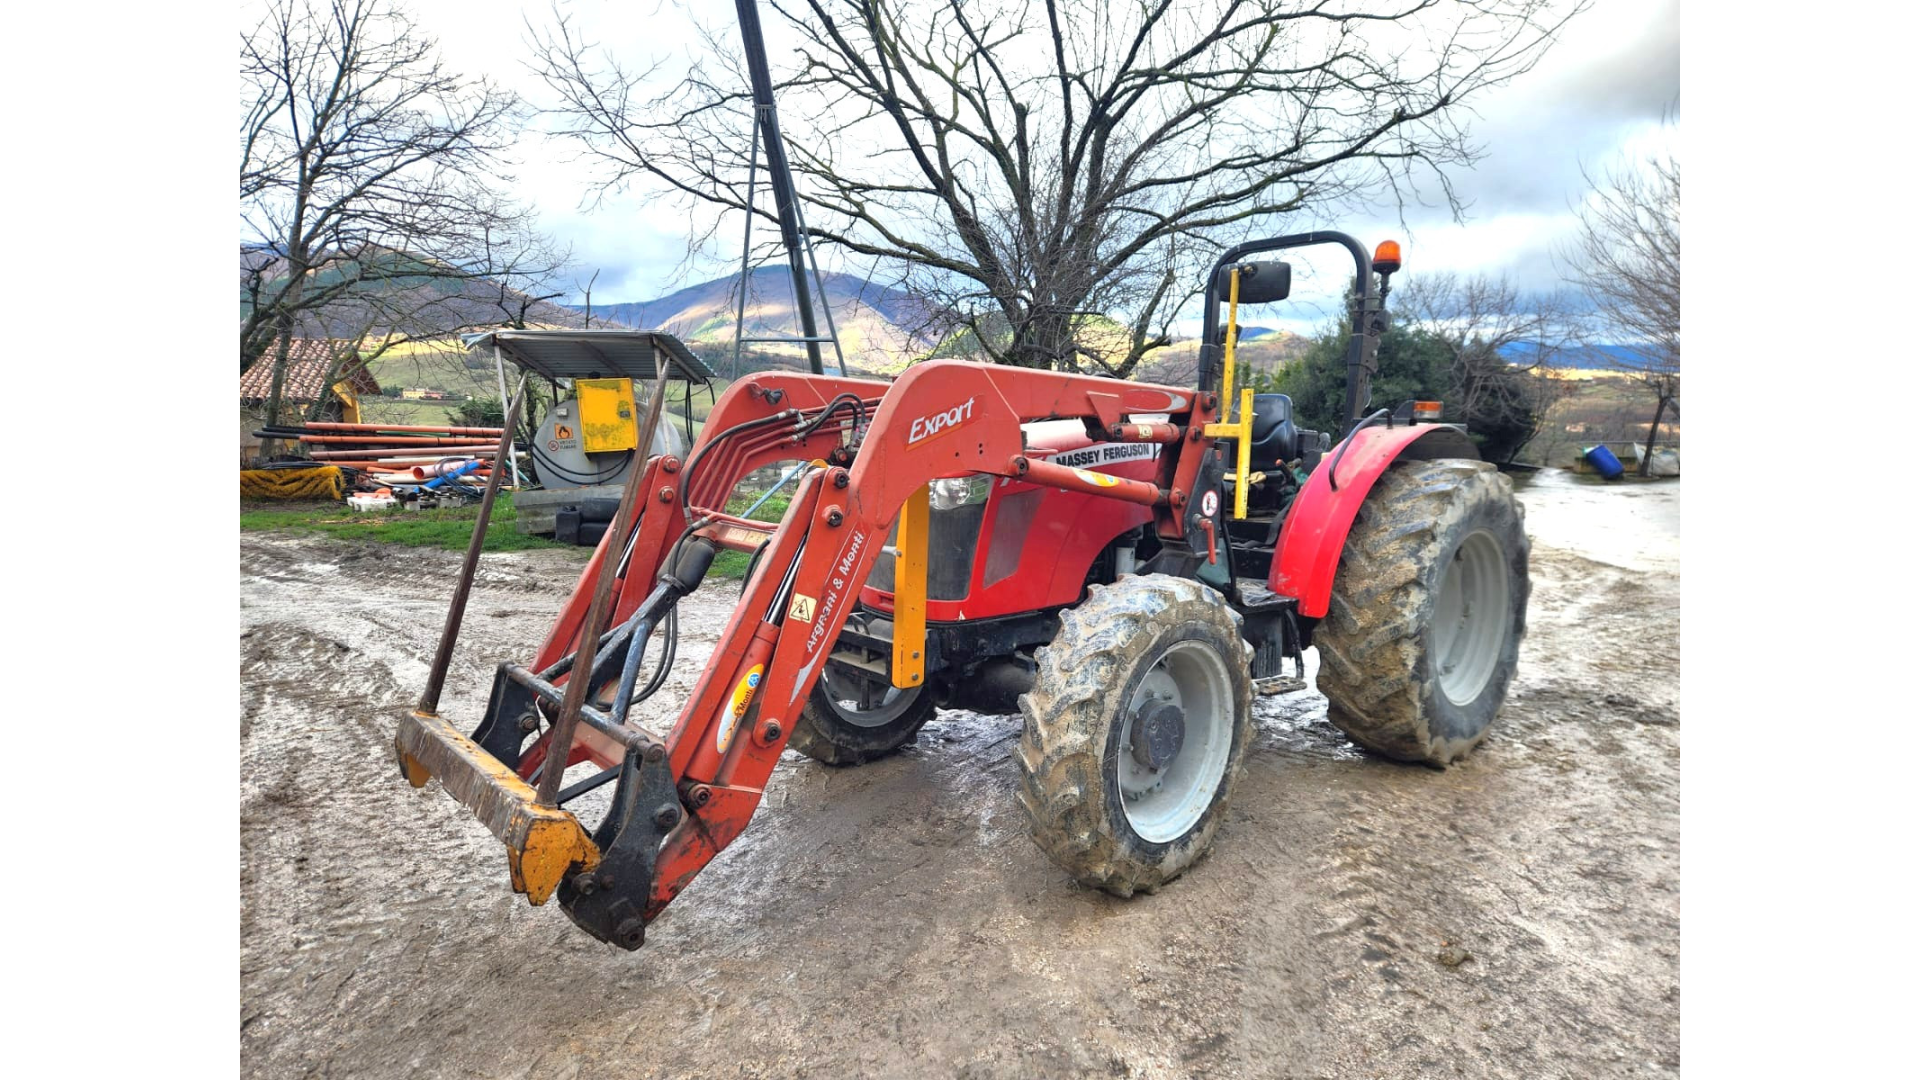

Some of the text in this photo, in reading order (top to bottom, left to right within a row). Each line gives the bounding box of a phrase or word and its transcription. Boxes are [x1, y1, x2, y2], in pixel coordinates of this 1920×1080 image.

[908, 397, 975, 444] Export
[1056, 443, 1149, 467] MASSEY FERGUSON
[806, 530, 865, 653] Argnani & Monti
